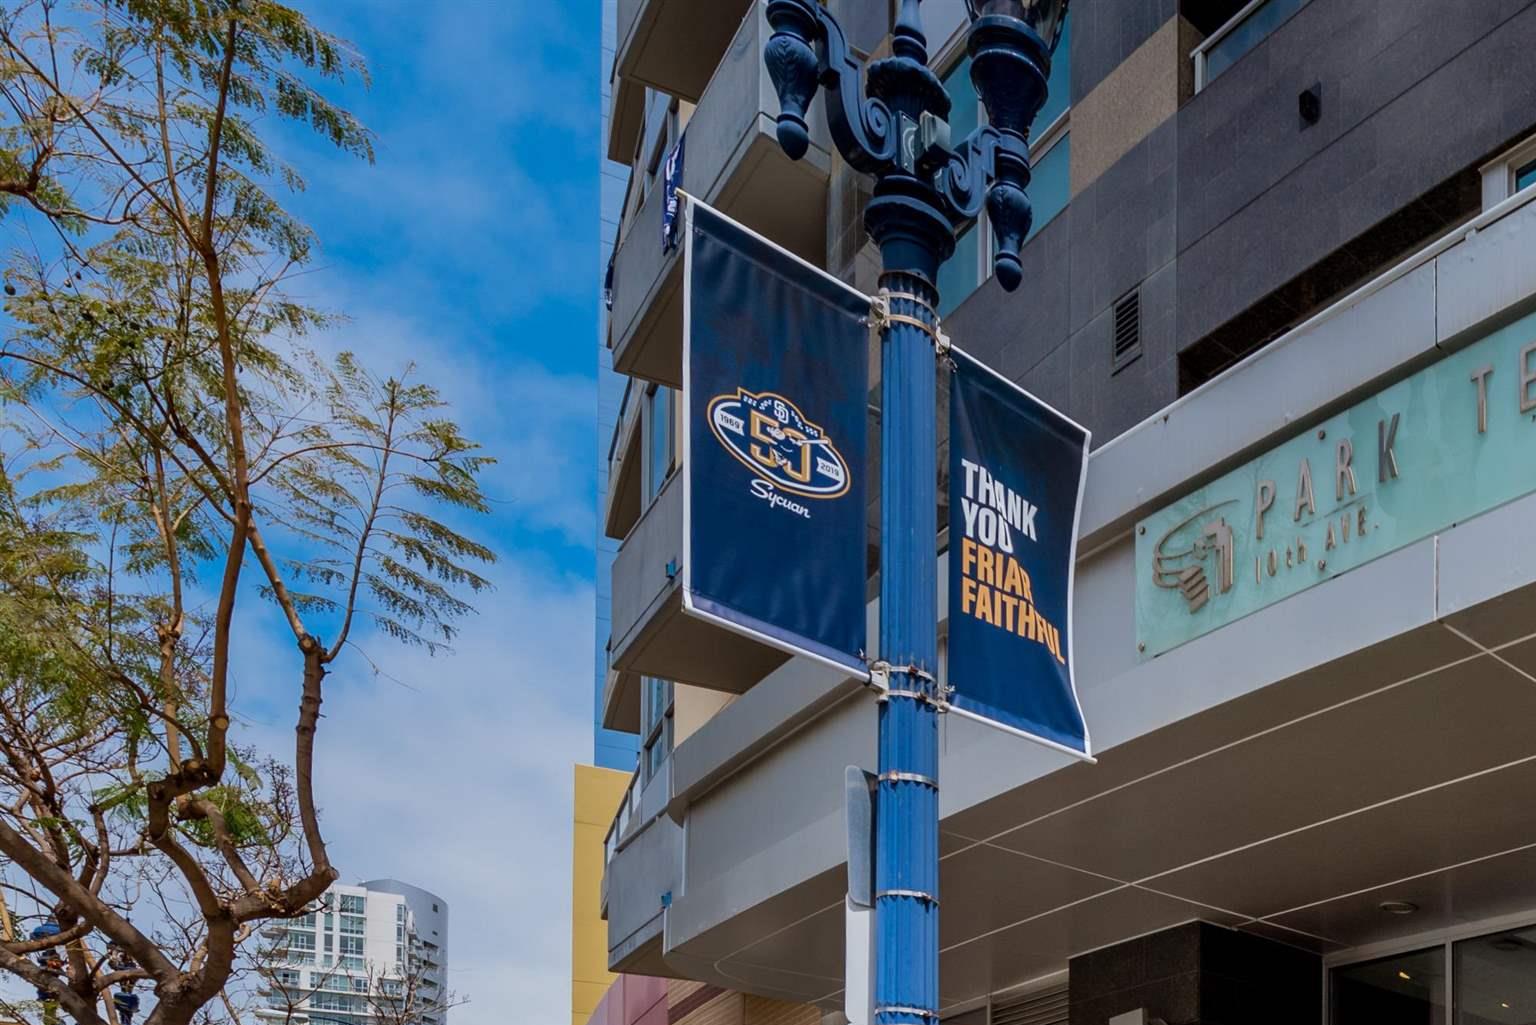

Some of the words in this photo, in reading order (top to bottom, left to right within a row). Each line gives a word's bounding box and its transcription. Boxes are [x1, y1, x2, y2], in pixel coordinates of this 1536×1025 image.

[750, 479, 811, 519] Sycuan
[961, 457, 1039, 543] THANK
[1255, 412, 1400, 541] PARK
[960, 496, 1014, 554] YOU
[961, 536, 1034, 604] FRIAR
[1255, 535, 1308, 585] 10th
[961, 575, 1066, 665] FAITHFUL
